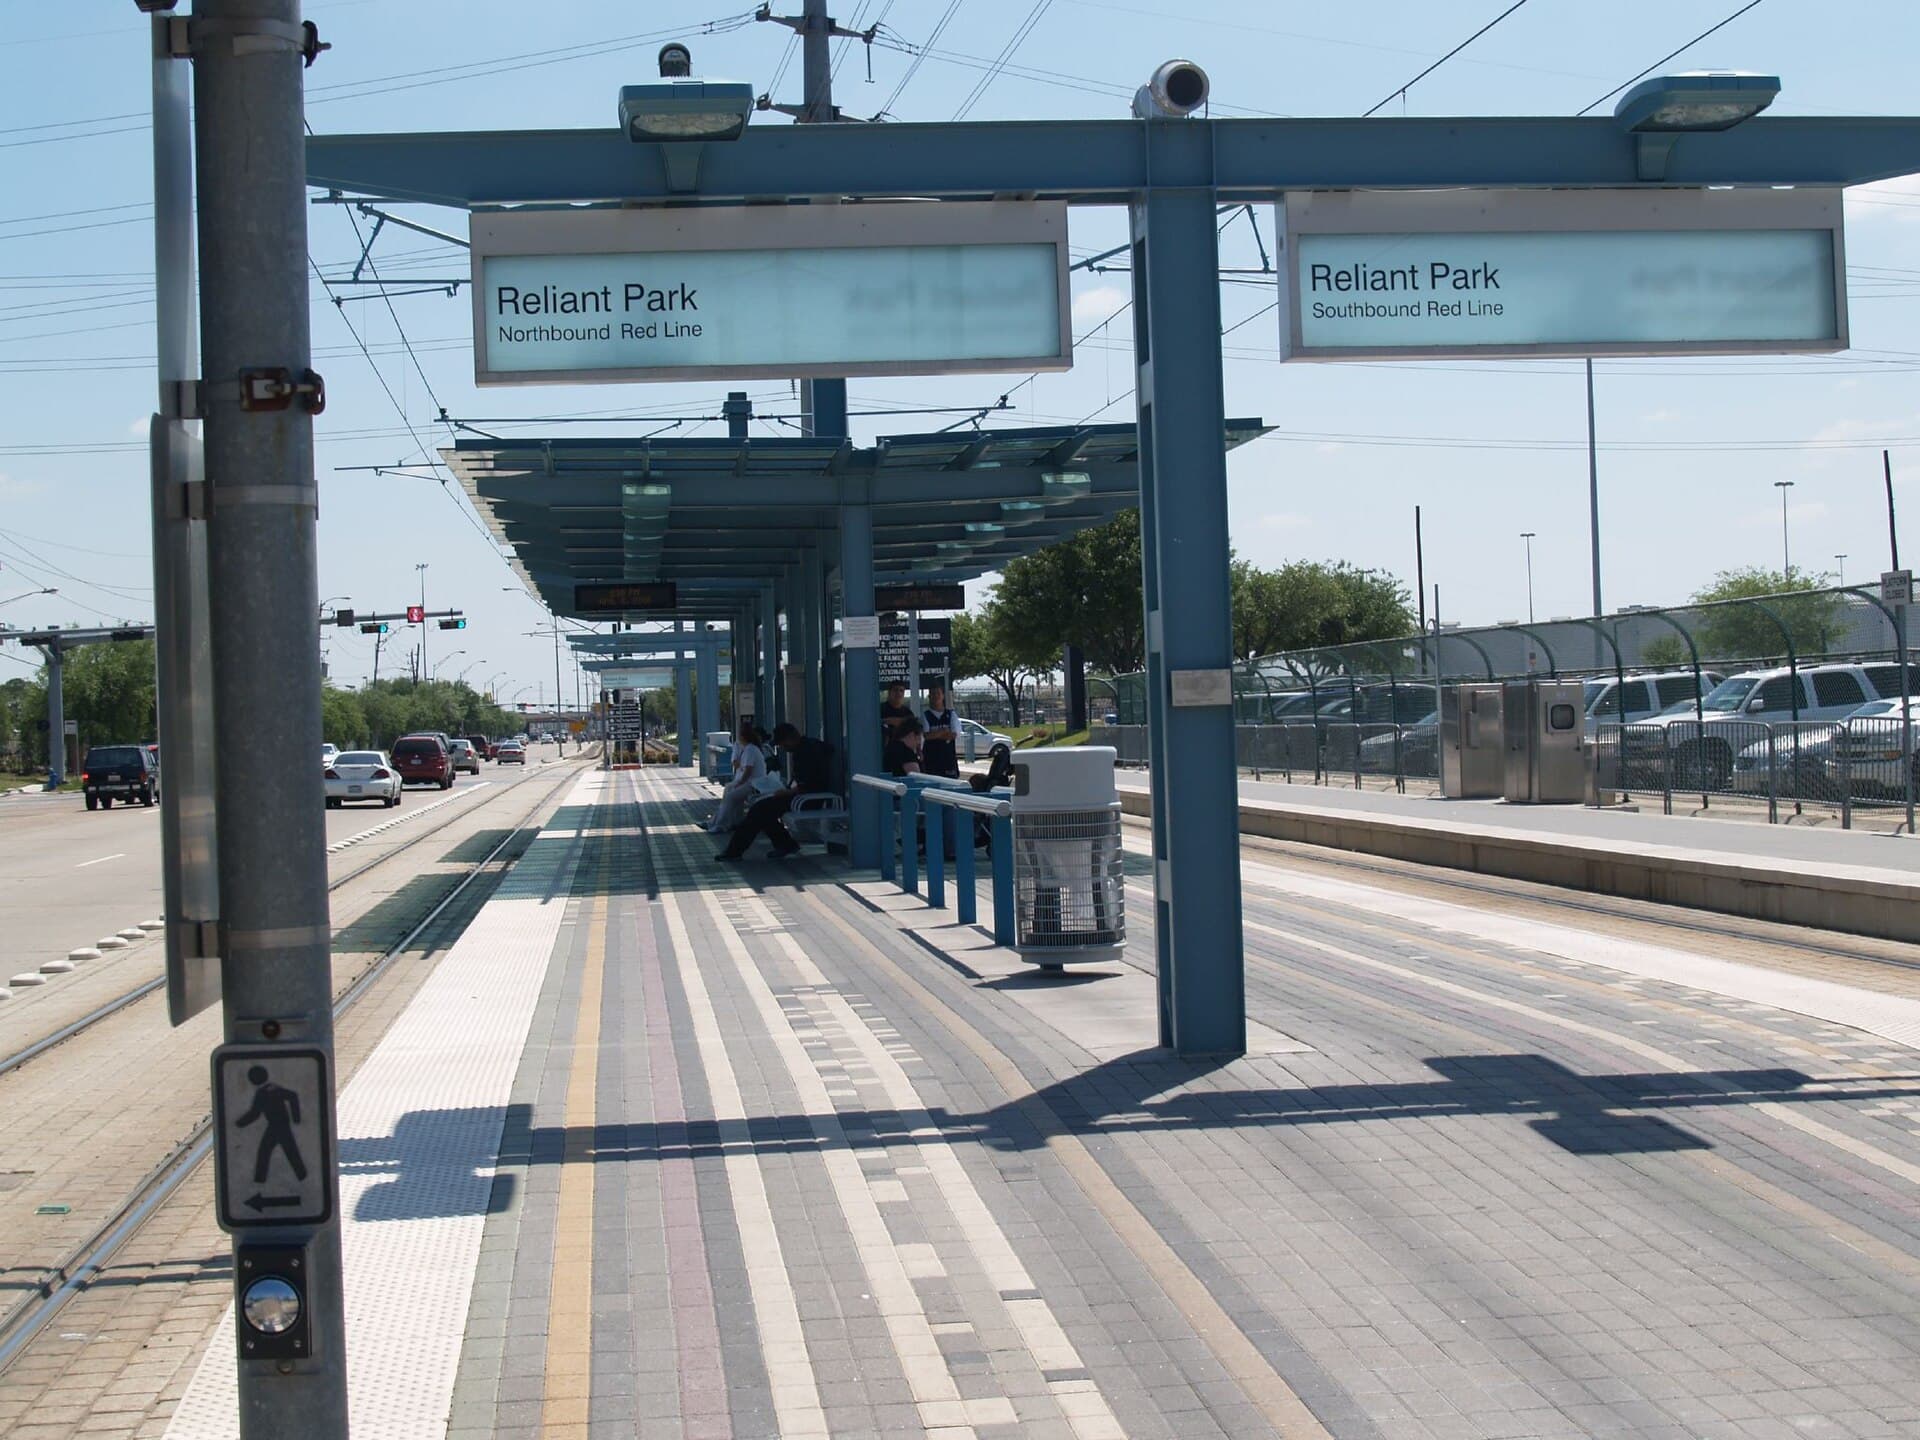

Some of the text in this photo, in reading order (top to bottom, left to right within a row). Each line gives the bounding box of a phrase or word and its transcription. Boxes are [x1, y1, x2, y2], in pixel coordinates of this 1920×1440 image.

[1311, 262, 1500, 291] Reliant Park
[498, 282, 698, 315] Reliant Park
[1312, 300, 1503, 319] Southbound Red Line
[499, 321, 703, 343] Northbound Red Line
